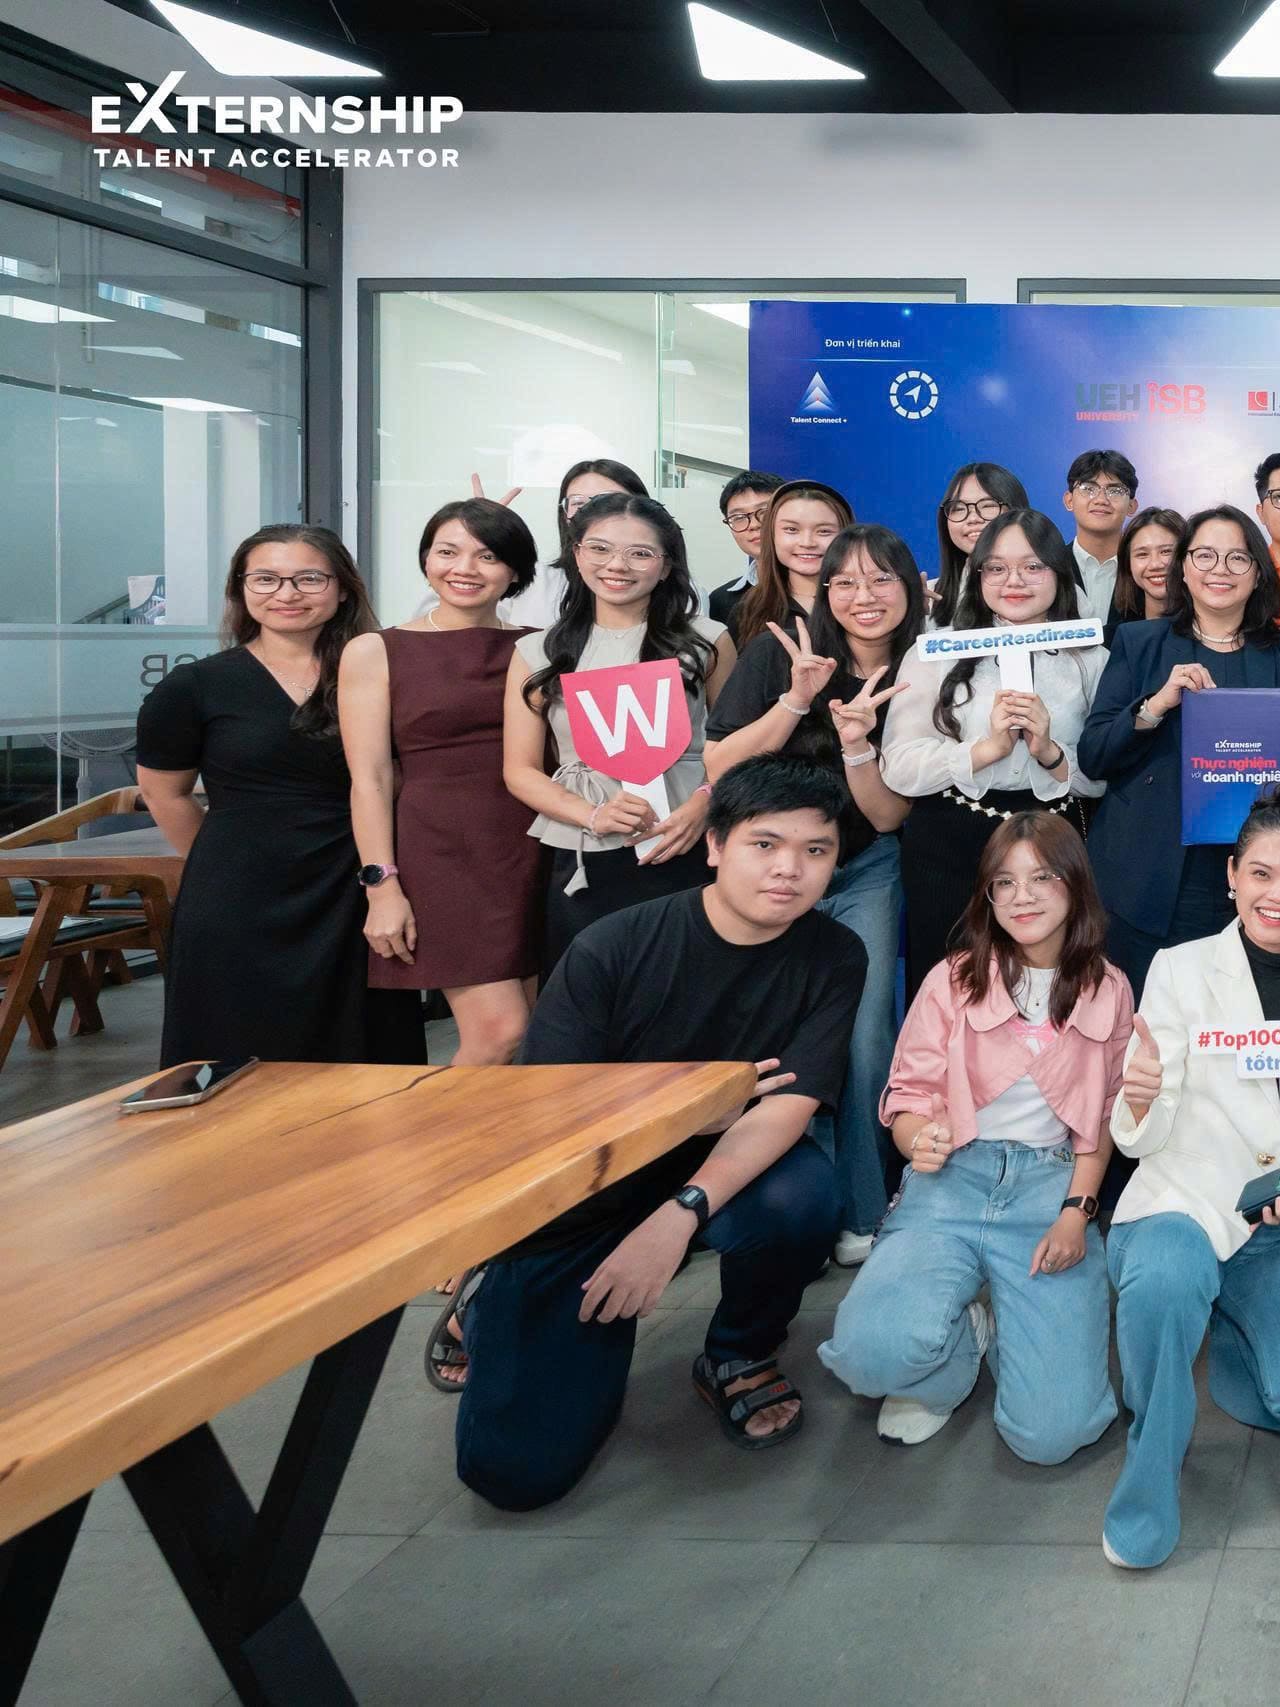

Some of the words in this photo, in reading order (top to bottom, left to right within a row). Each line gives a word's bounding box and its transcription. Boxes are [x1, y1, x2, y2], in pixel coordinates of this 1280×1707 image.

[825, 338, 845, 348] Đơn
[880, 339, 901, 348] khai
[1076, 383, 1140, 411] UEH
[925, 626, 1097, 653] #CareerReadiness
[576, 678, 671, 757] W
[1215, 740, 1262, 748] EXTERNSHIP
[1191, 757, 1226, 771] Thực
[1228, 756, 1277, 771] nghiệm
[1203, 771, 1244, 782] doanh
